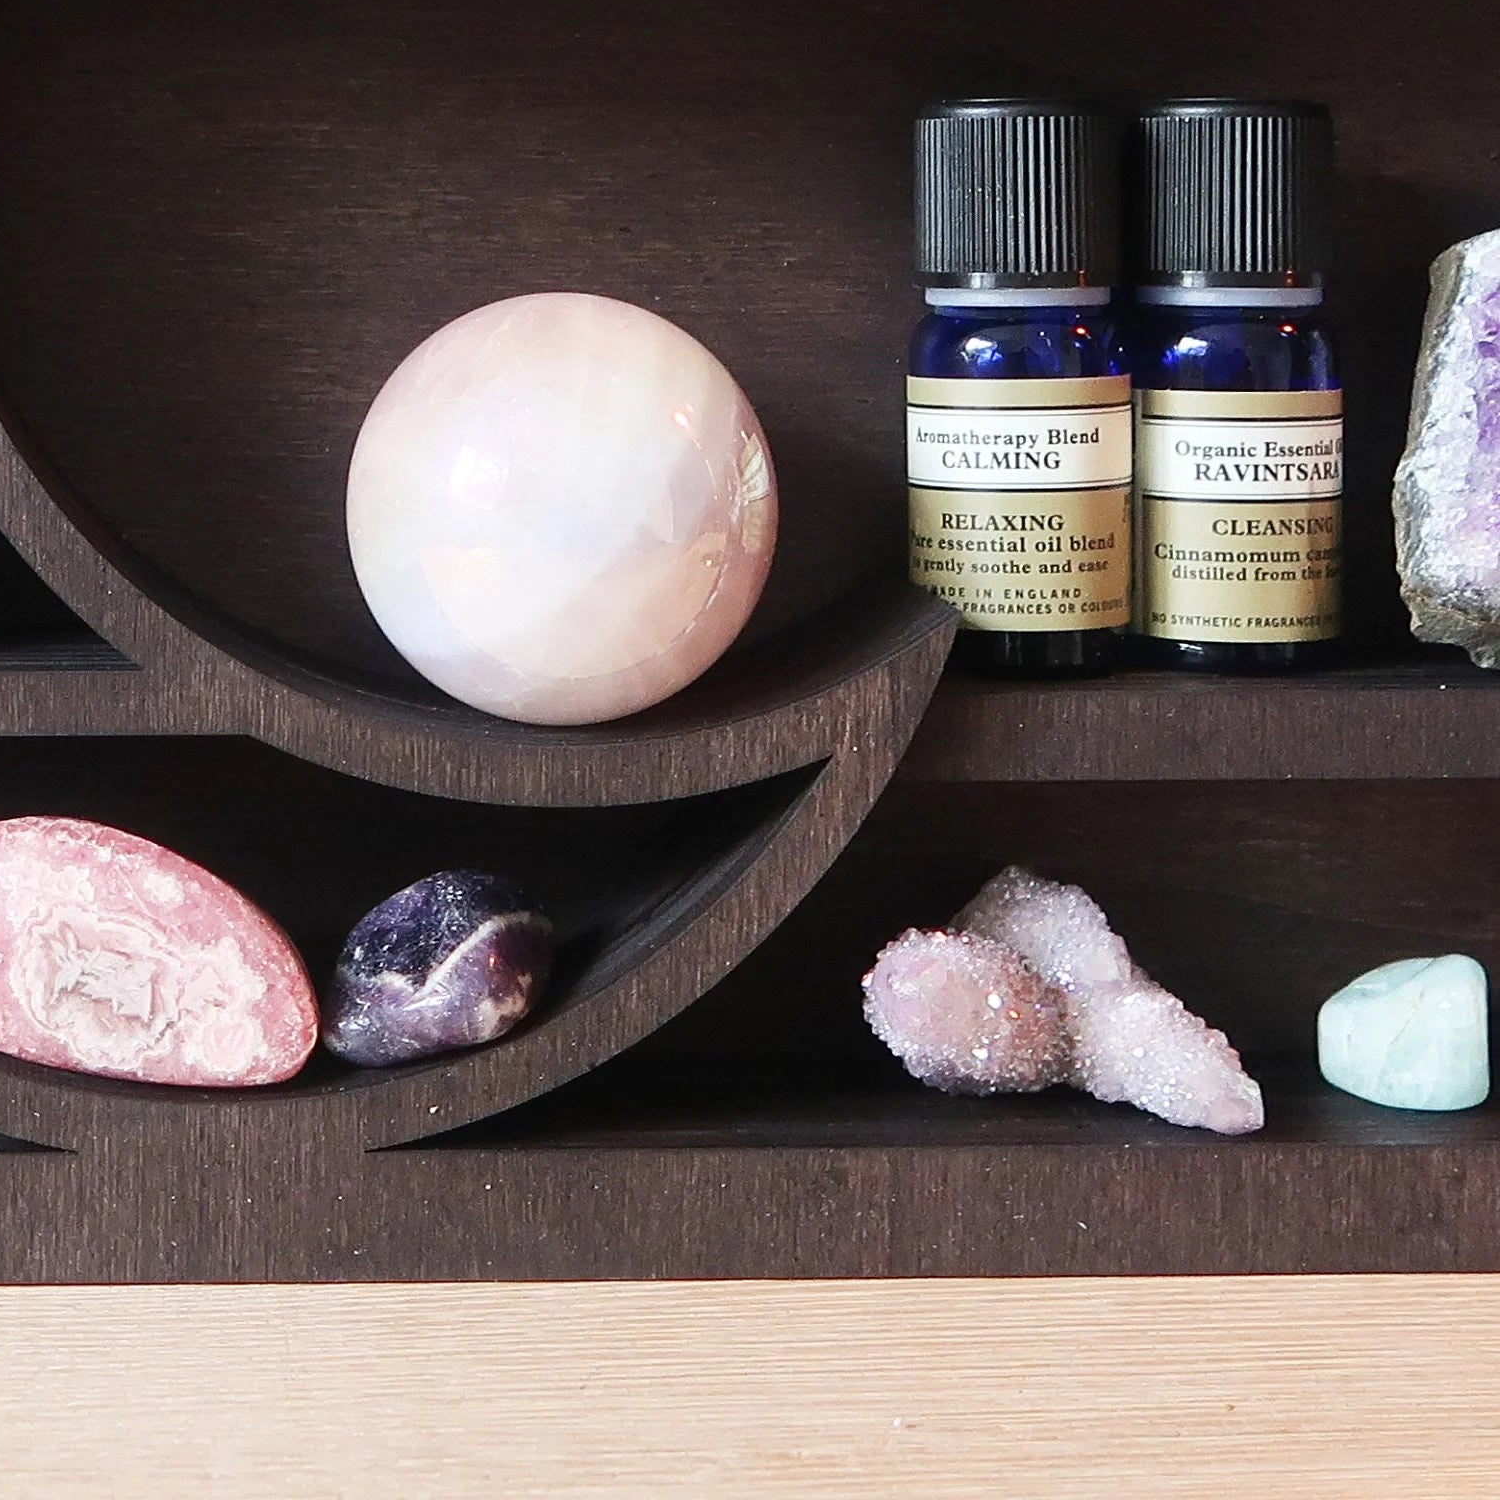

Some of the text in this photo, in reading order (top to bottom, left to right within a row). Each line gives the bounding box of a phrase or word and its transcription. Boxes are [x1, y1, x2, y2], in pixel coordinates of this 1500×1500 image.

[915, 426, 1100, 449] Aromatherapy Blend
[1175, 439, 1258, 461] Organic
[1264, 439, 1334, 458] Essential
[942, 450, 1062, 471] CALMING
[941, 513, 1065, 532] RELAXING
[1212, 516, 1333, 537] CLEANSING
[937, 536, 1027, 553] essential
[1035, 536, 1062, 553] oil
[1070, 532, 1115, 553] blend
[1154, 543, 1301, 564] Cinnamomum
[923, 557, 965, 575] gently
[970, 560, 1032, 575] soothe
[1038, 559, 1072, 574] and
[1078, 559, 1110, 573] ease
[1172, 564, 1247, 581] distilled
[1253, 566, 1297, 581] from
[975, 588, 993, 599] IN
[1003, 587, 1082, 600] ENGLAND
[962, 602, 1053, 615] FRAGRANCES
[1058, 602, 1076, 614] OR
[1151, 611, 1167, 625] NO
[1170, 613, 1242, 628] SYNTHETIC
